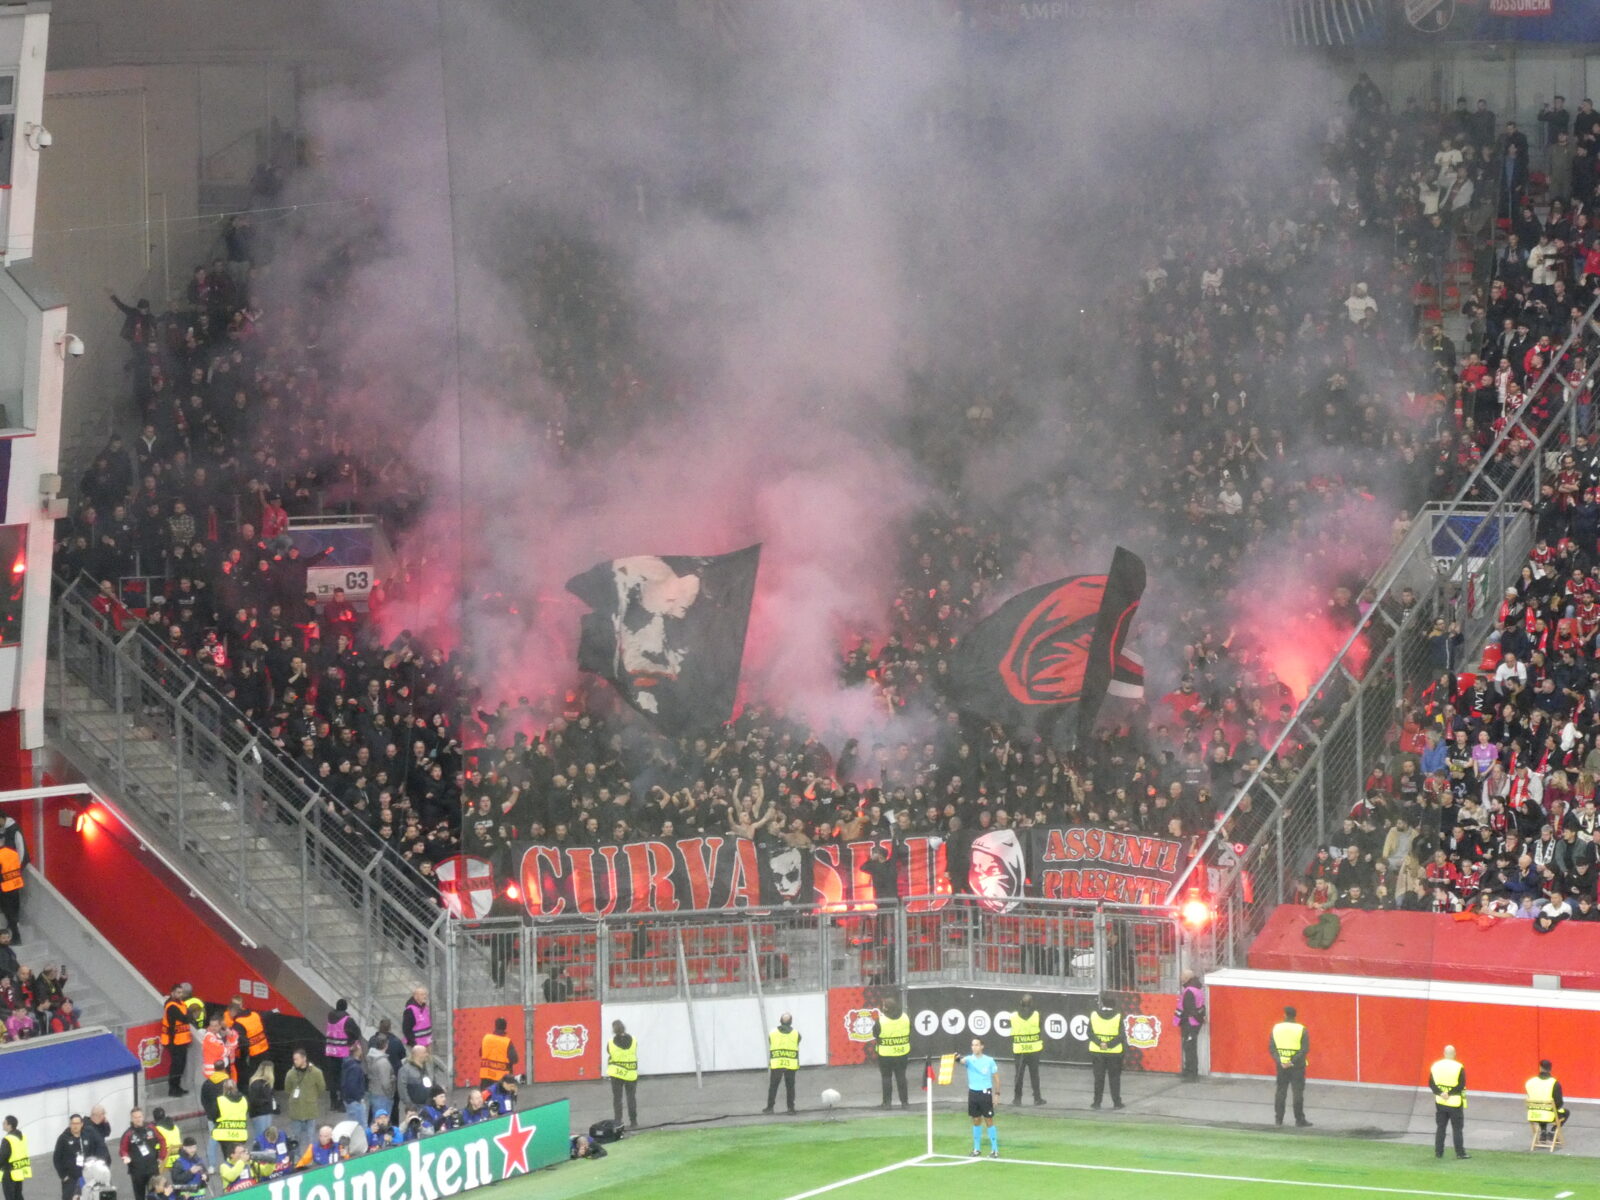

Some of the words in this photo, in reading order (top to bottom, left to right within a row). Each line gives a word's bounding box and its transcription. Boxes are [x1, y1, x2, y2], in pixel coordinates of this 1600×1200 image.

[345, 571, 369, 590] G3
[1043, 827, 1181, 873] ASSENTI
[521, 837, 771, 921] CURVA
[1043, 868, 1172, 904] PRESENTI
